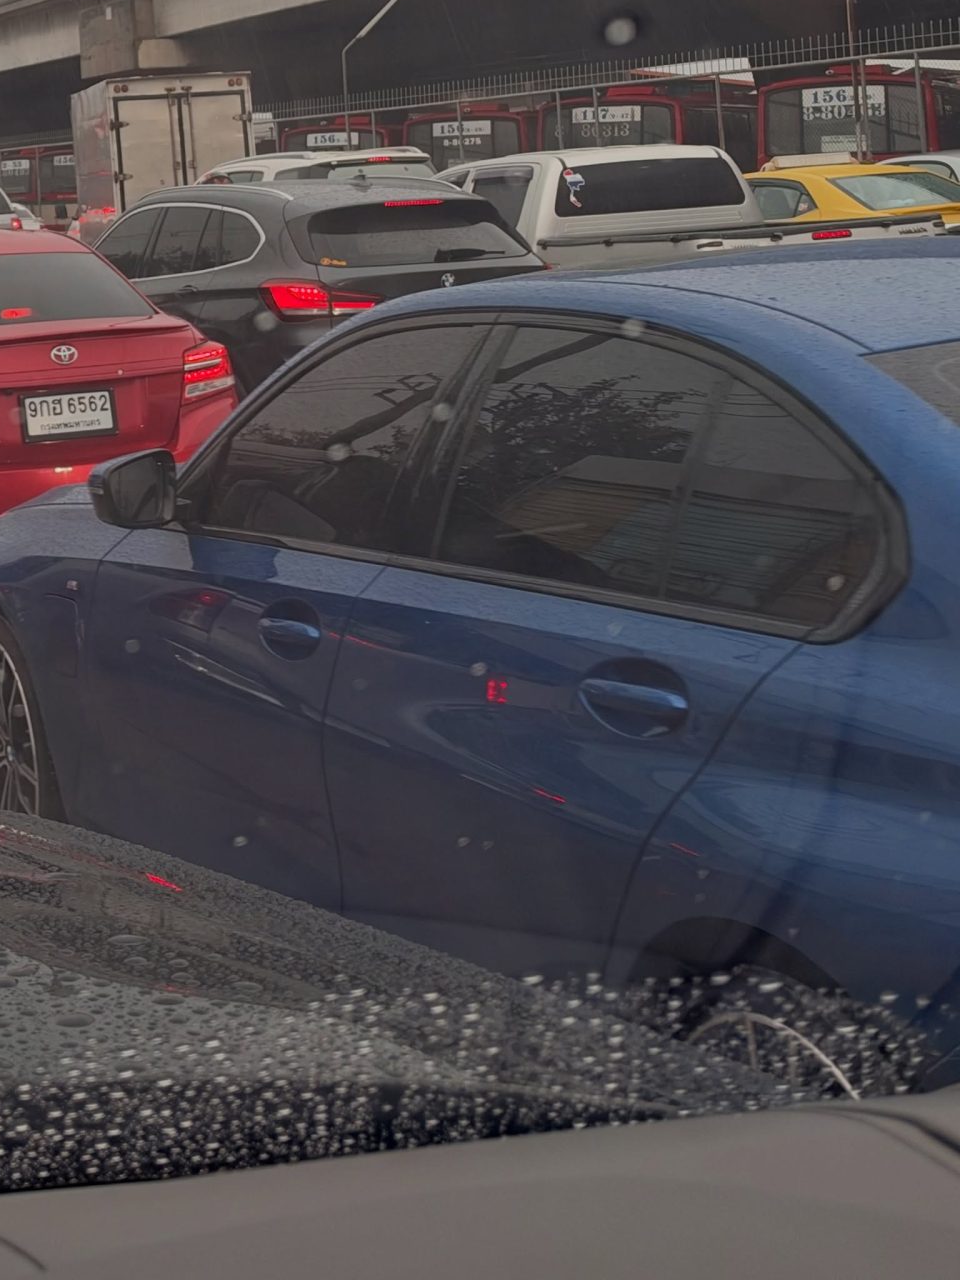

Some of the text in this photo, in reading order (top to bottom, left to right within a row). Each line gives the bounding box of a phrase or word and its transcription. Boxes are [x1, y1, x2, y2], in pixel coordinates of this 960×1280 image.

[811, 89, 848, 105] 156
[802, 103, 886, 121] 8-8043
[314, 135, 336, 145] 156
[67, 394, 109, 414] 6562
